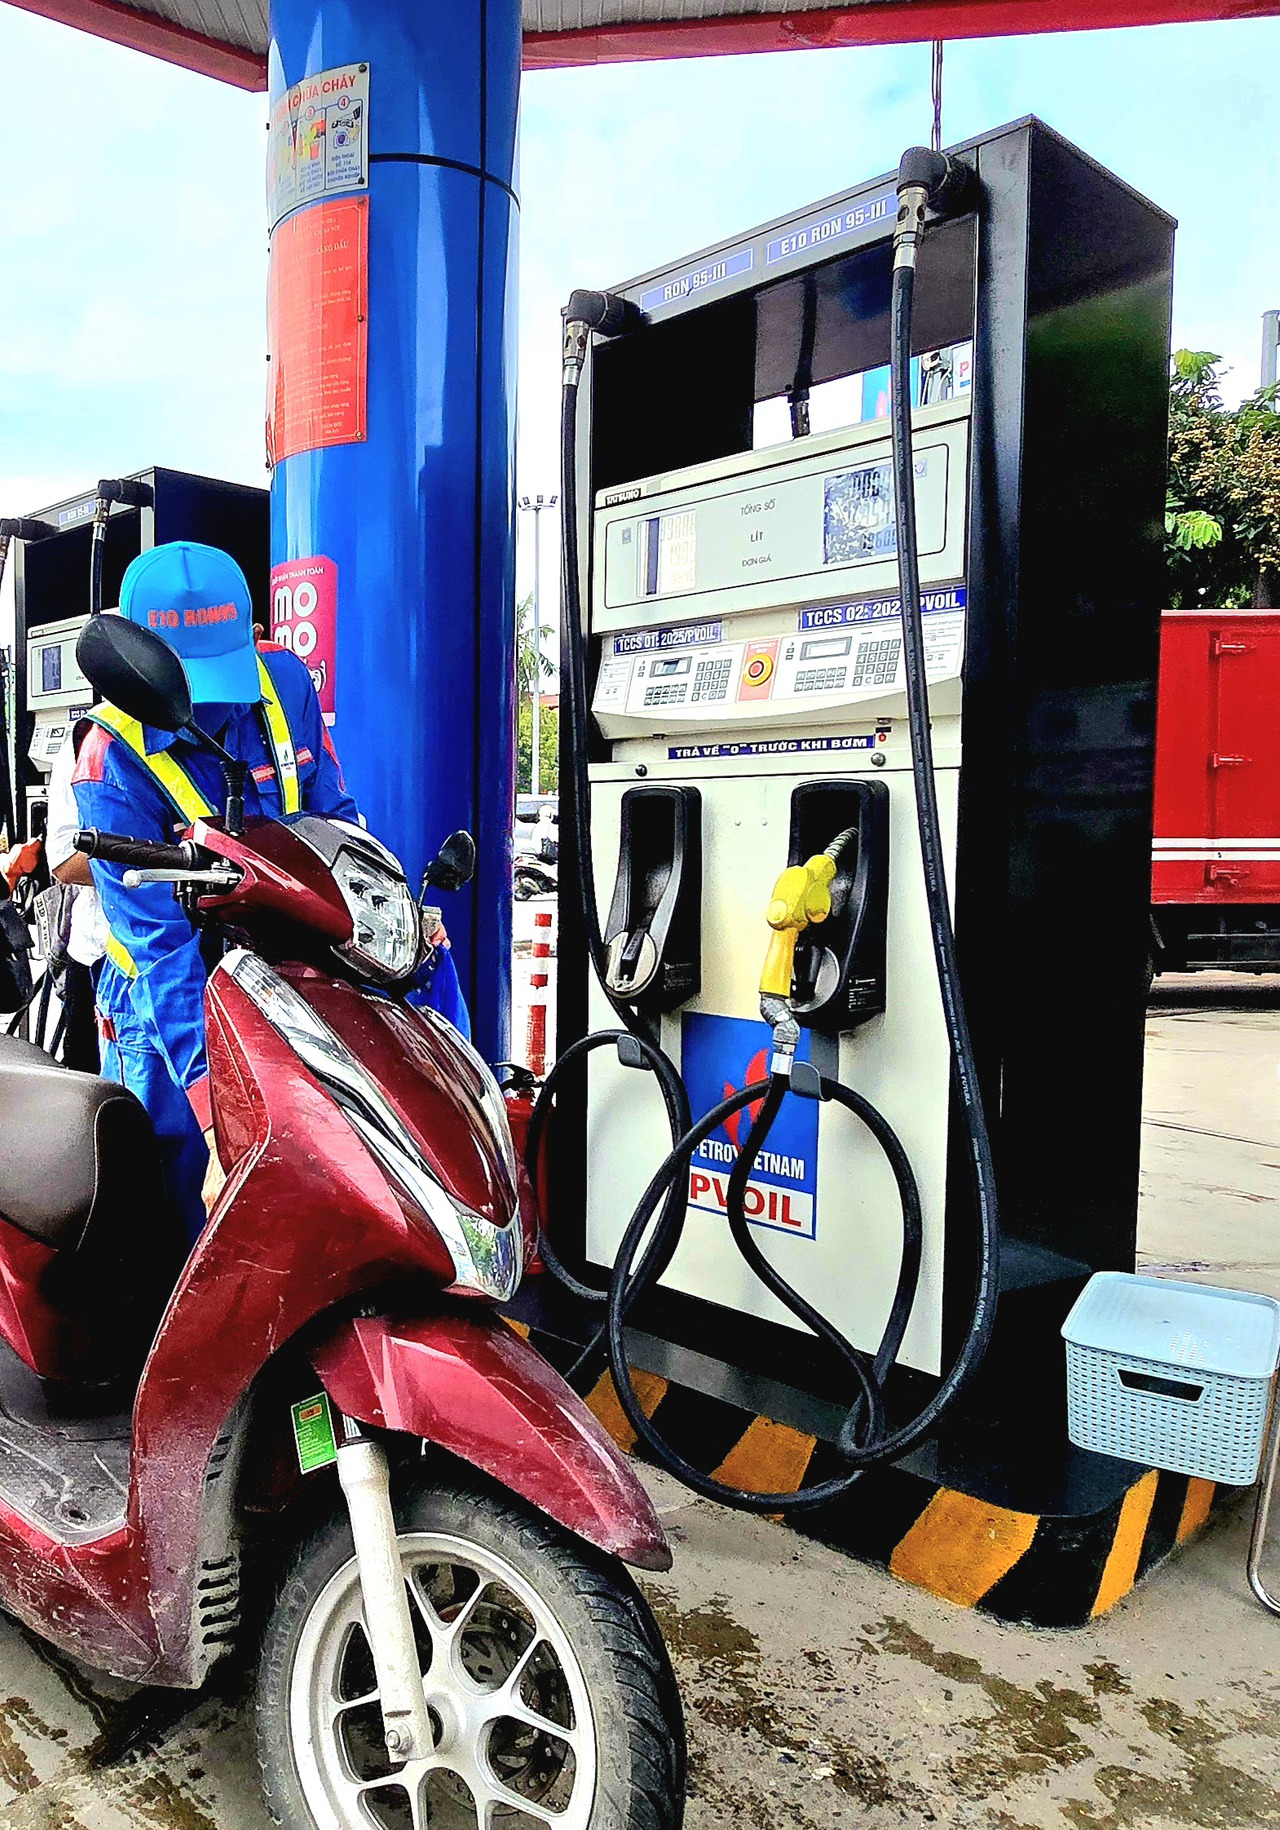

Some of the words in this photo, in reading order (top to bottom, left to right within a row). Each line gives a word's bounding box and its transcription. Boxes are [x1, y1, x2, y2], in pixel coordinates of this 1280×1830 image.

[322, 74, 356, 93] CHÁY
[781, 233, 807, 255] E10
[811, 218, 842, 244] RON
[846, 200, 886, 229] 95-III
[664, 283, 690, 301] RON
[693, 263, 726, 288] 95-III
[750, 530, 764, 543] LÍT
[806, 610, 842, 627] TCCS
[618, 636, 643, 651] TCCS
[675, 746, 699, 758] TRẢ
[703, 746, 720, 757] VỀ
[750, 740, 798, 753] TRƯỚC
[801, 739, 827, 750] KHI
[831, 738, 867, 748] BƠM
